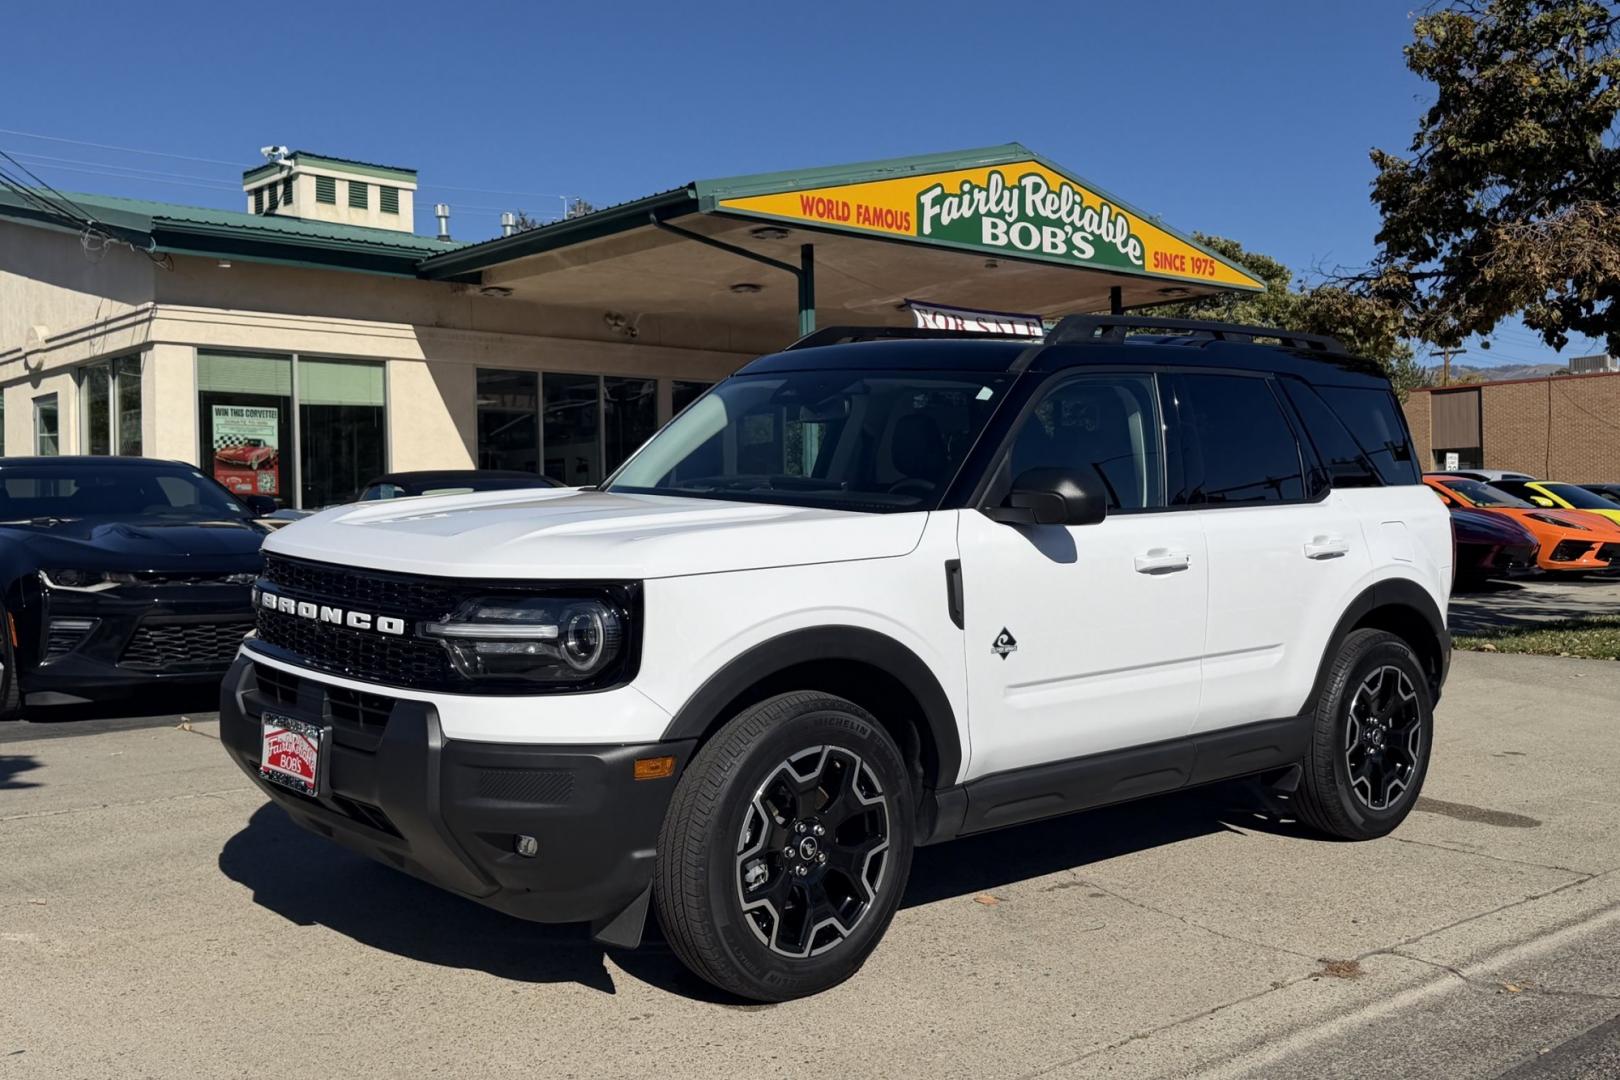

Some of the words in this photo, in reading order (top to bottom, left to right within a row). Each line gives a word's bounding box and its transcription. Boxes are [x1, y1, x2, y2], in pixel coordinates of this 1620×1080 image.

[800, 194, 851, 222] WORLD
[856, 203, 911, 232] FAMOUS
[920, 173, 1019, 235] Fairly
[1021, 175, 1143, 265] Reliable
[981, 215, 1095, 259] BOB'S
[1153, 250, 1186, 272] SINCE
[1190, 256, 1215, 276] 1975
[215, 408, 229, 417] WIN
[230, 408, 245, 418] THIS
[245, 409, 278, 419] CORVETTE!
[261, 591, 404, 635] BRONCO
[813, 717, 868, 736] MICHELIN
[280, 754, 303, 774] BOB'S
